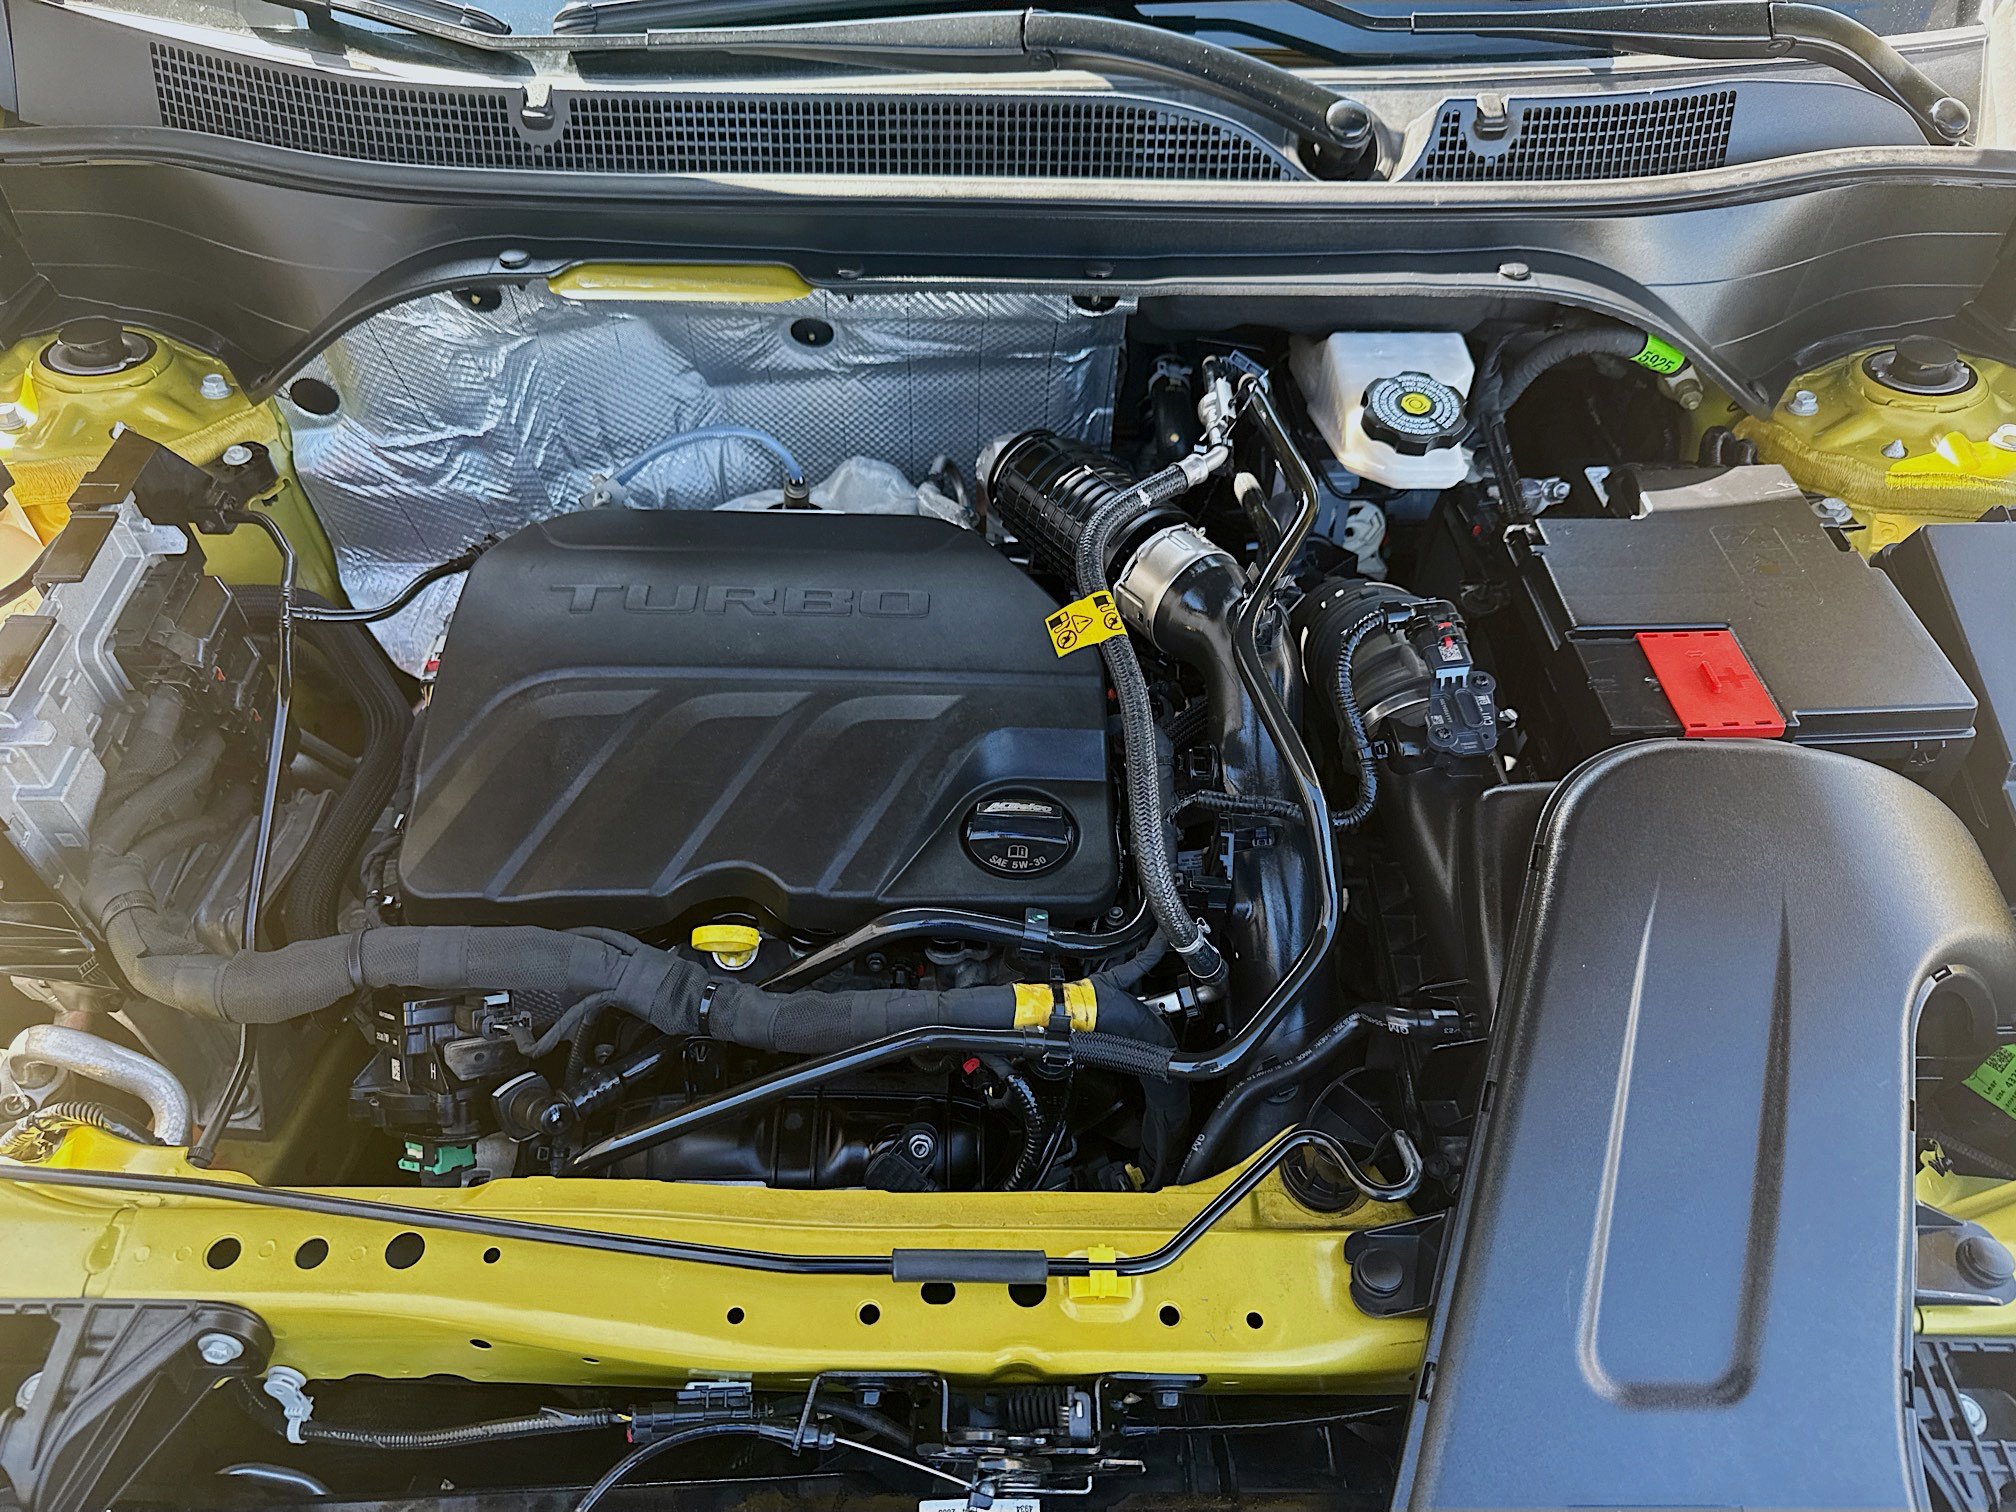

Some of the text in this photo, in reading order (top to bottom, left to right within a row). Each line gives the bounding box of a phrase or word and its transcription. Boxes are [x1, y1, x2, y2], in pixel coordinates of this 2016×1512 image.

[1638, 351, 1675, 371] 5925
[550, 584, 931, 619] TURBO
[989, 855, 1047, 869] SAE 5W-30
